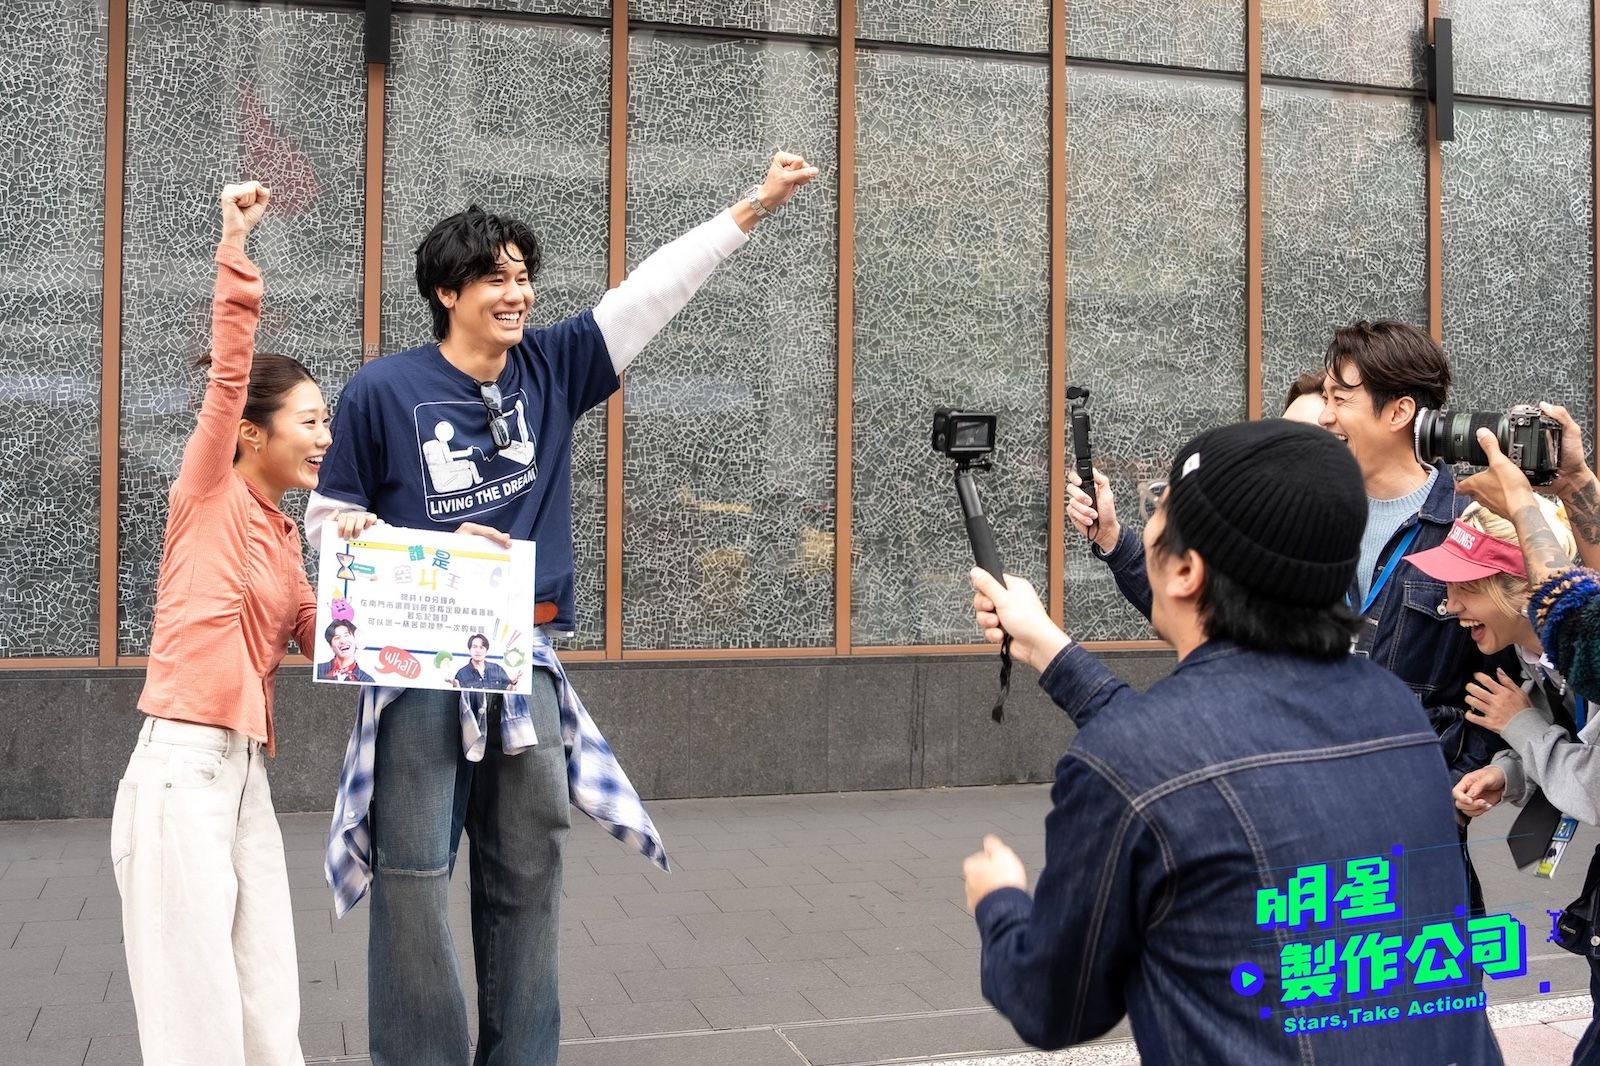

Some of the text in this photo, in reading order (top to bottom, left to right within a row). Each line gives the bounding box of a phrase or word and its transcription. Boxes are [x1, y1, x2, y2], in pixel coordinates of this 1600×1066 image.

[430, 468, 537, 515] LIVING THE DREAM
